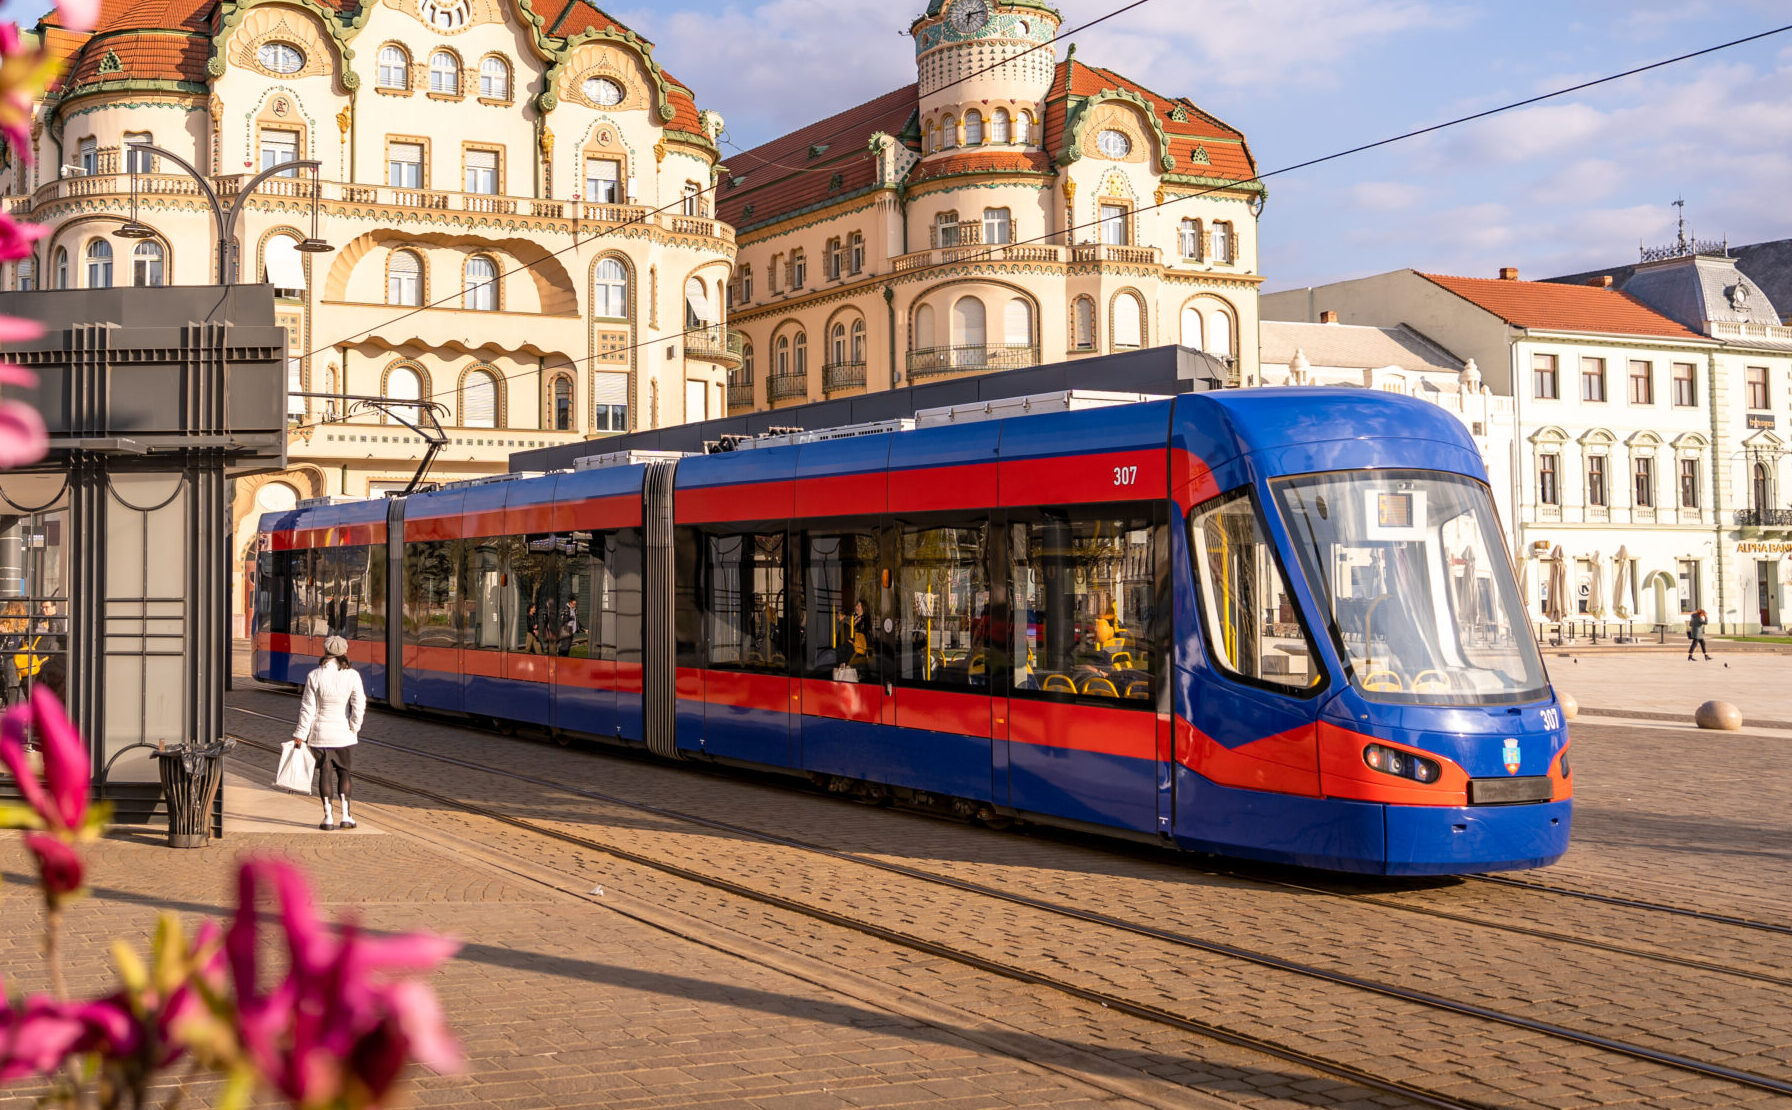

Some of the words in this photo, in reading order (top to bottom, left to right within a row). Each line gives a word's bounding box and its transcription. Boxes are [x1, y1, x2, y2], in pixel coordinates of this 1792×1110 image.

[1113, 466, 1137, 486] 307
[1736, 543, 1768, 553] ALPHA
[1540, 708, 1560, 731] 307
